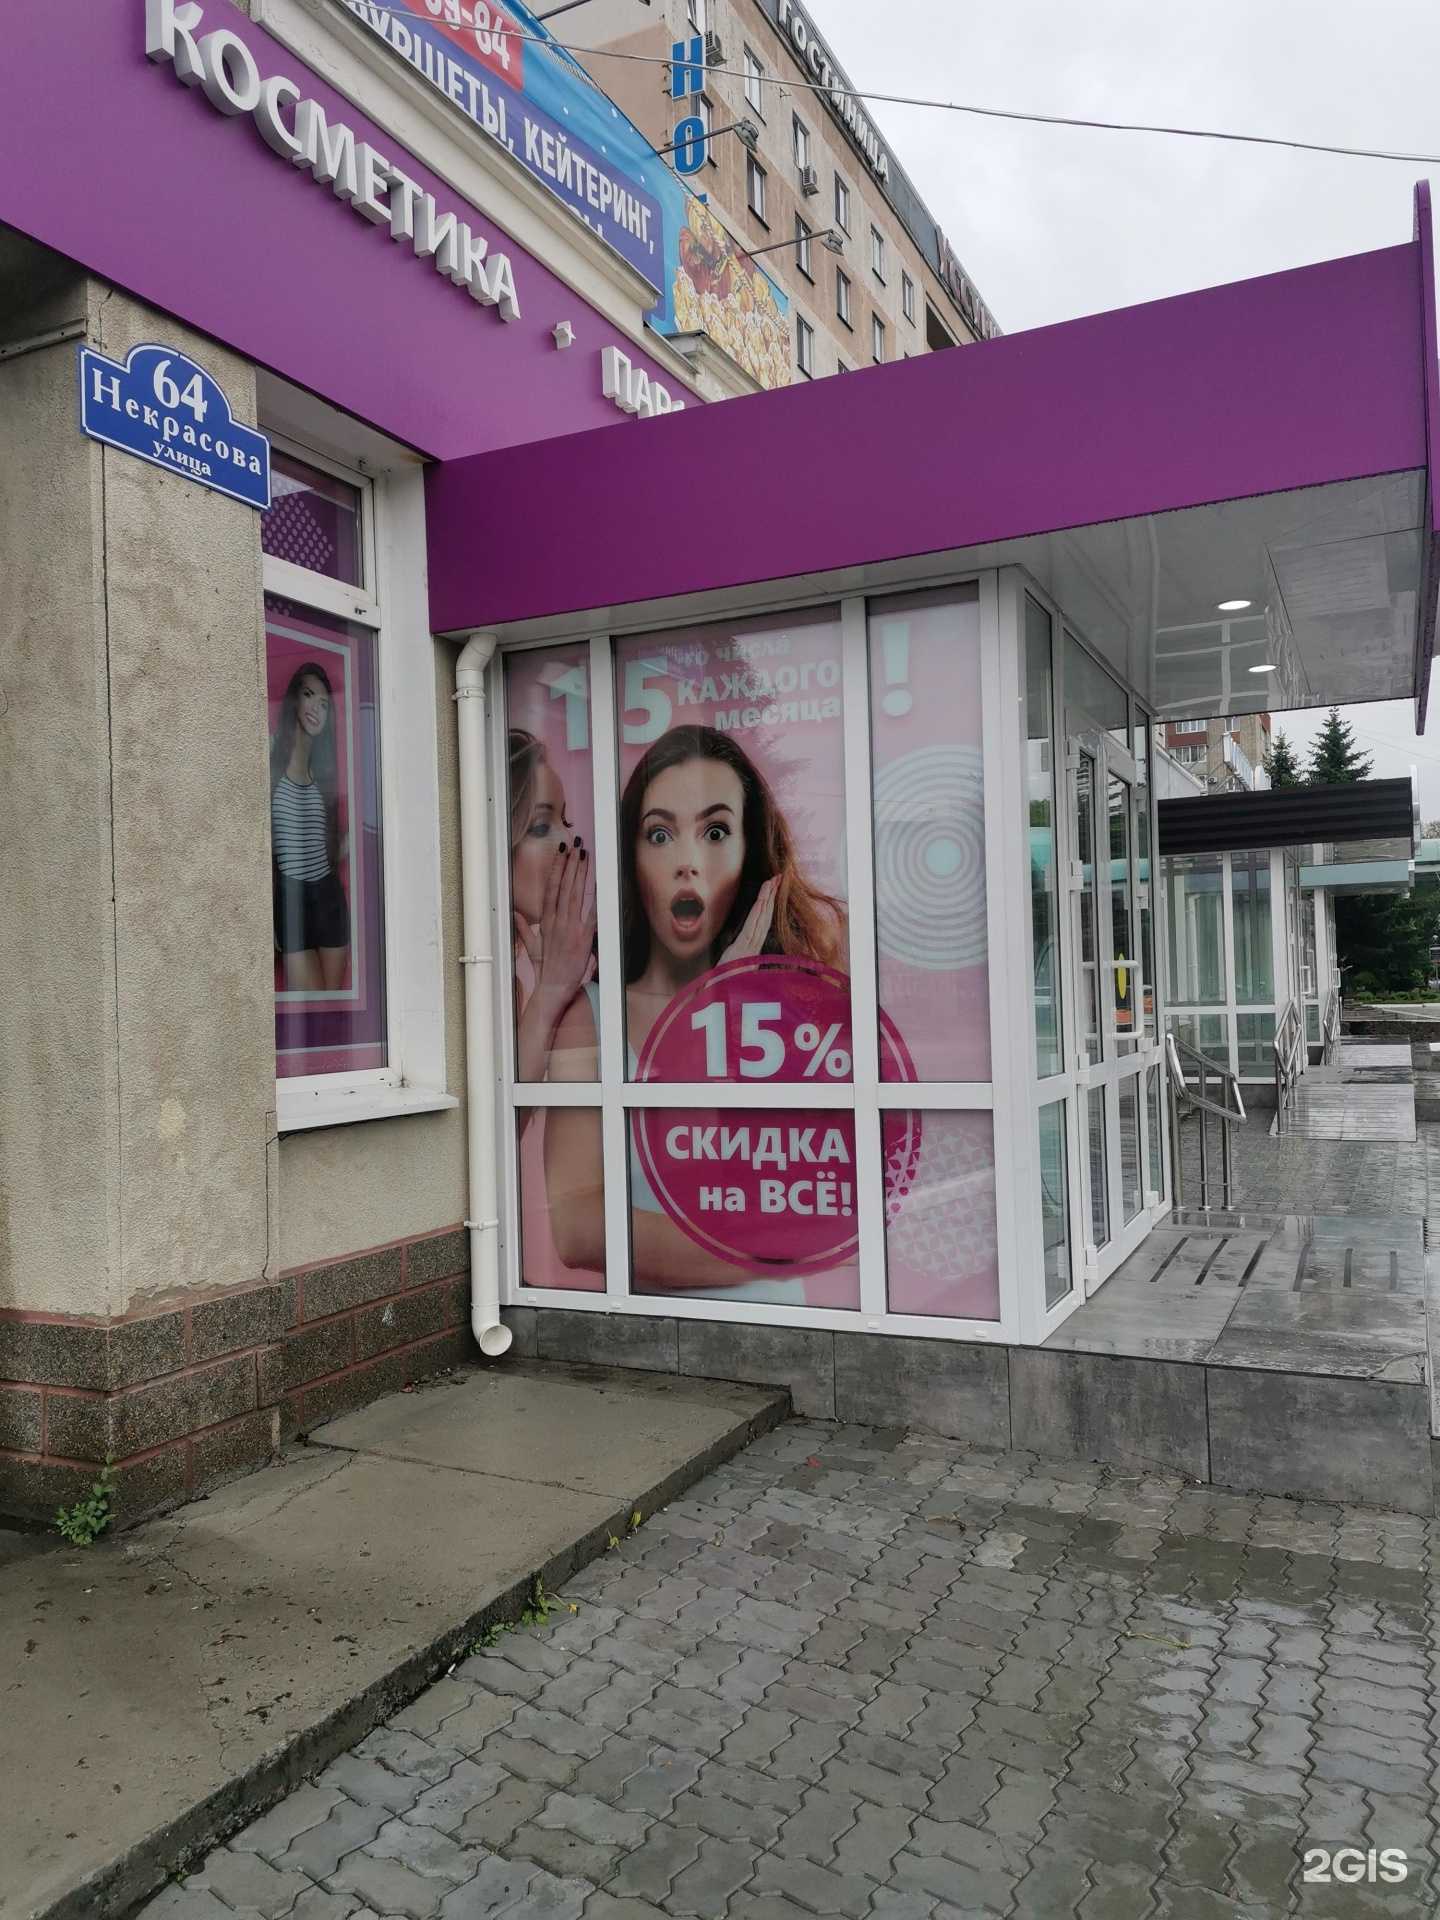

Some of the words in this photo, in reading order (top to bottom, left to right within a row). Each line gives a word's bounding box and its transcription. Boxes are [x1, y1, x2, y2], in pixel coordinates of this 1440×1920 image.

[778, 0, 889, 185] ГОСТИНИЦА
[145, 0, 521, 322] КОСМЕТИКА
[601, 346, 685, 419] ПАР
[524, 116, 655, 255] КЕЙТЕРИНГ,
[92, 367, 262, 476] Некрасова
[153, 360, 208, 423] 64
[152, 440, 212, 477] улица
[714, 695, 841, 731] месяца
[665, 1126, 850, 1171] СКИДКА
[700, 1186, 746, 1212] на
[760, 1171, 853, 1217] ВСЁ!
